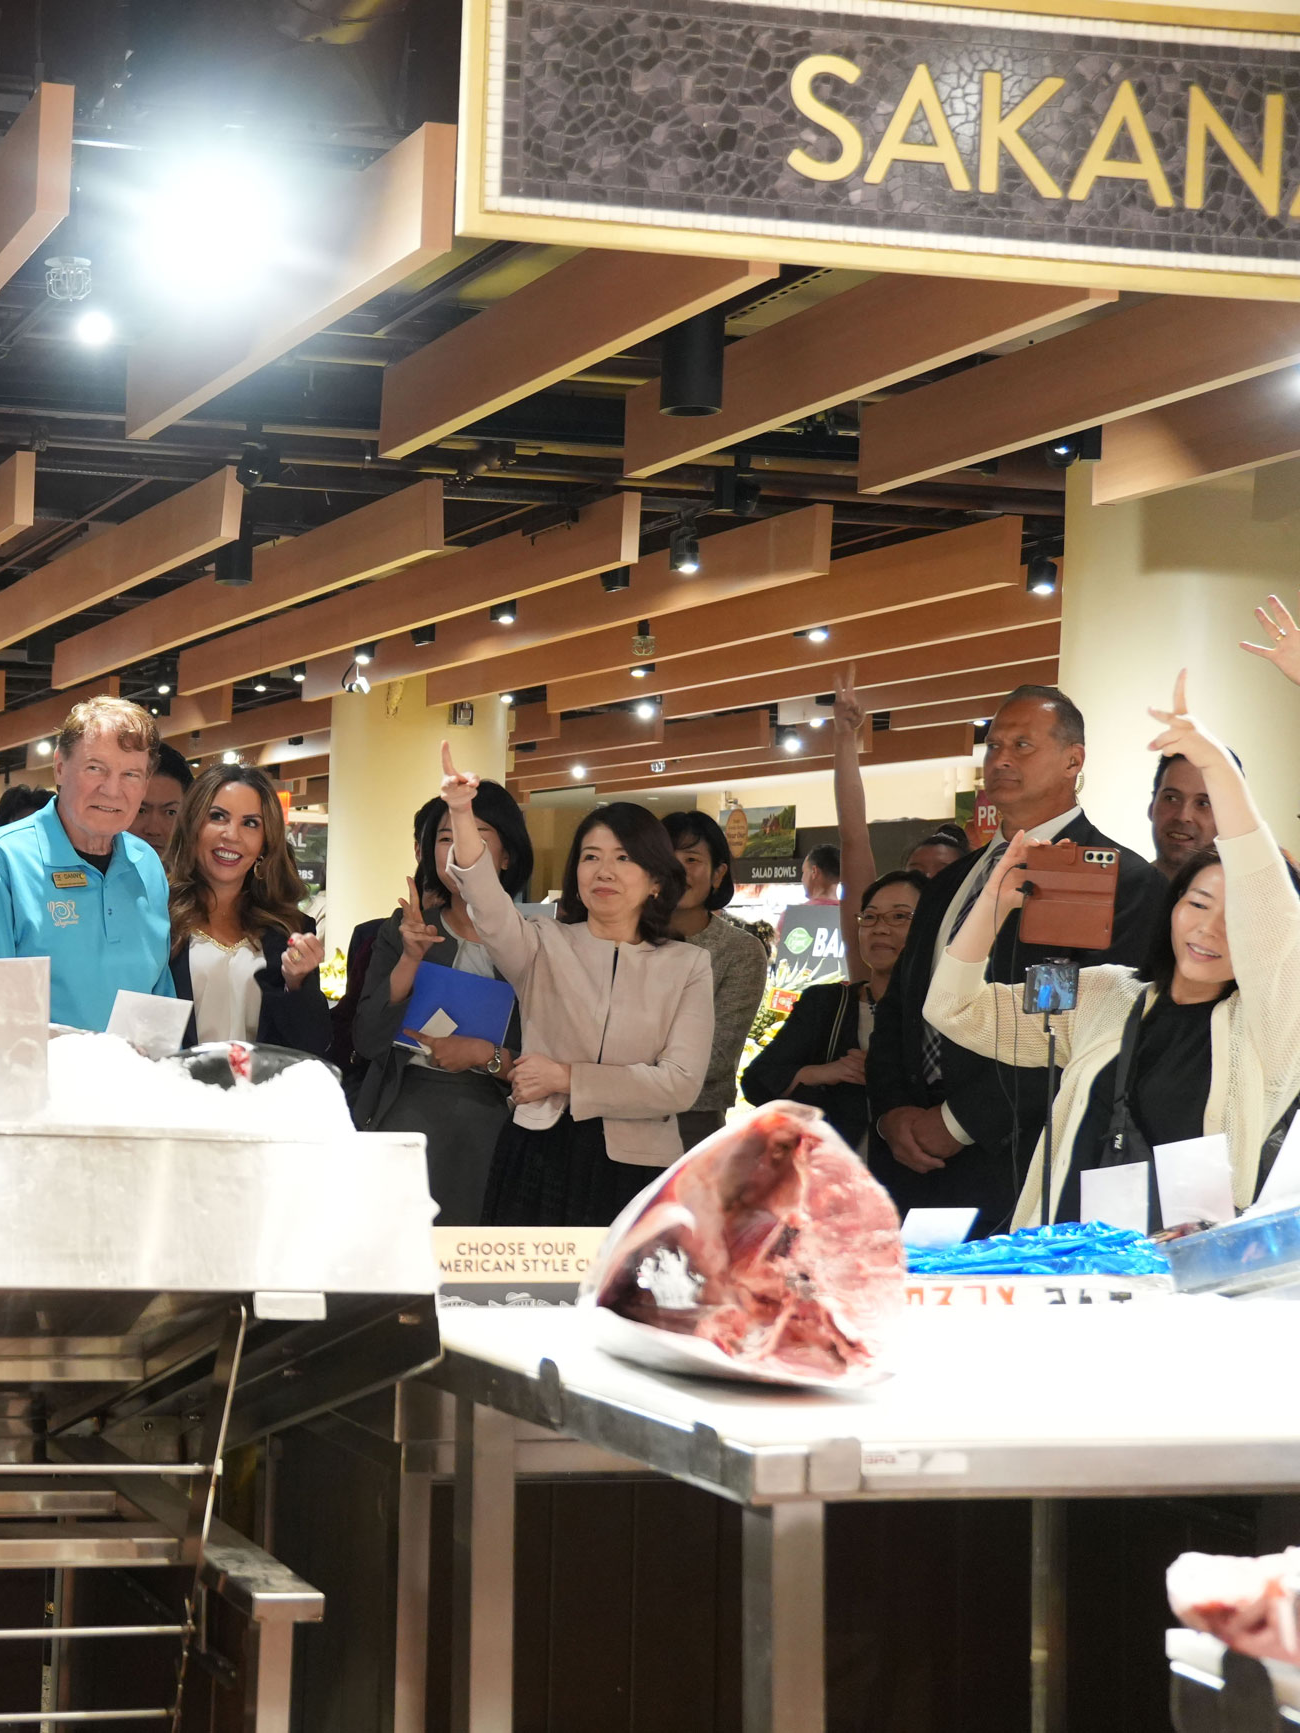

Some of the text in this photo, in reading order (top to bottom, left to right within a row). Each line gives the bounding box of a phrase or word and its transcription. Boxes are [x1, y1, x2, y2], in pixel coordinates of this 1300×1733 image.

[787, 53, 1300, 218] SAKAN
[751, 866, 797, 879] SALAD BOWLS
[1114, 1133, 1123, 1150] FILA
[456, 1242, 576, 1256] CHOOSE YOUR
[522, 1259, 569, 1272] STYLE
[576, 1259, 590, 1272] C
